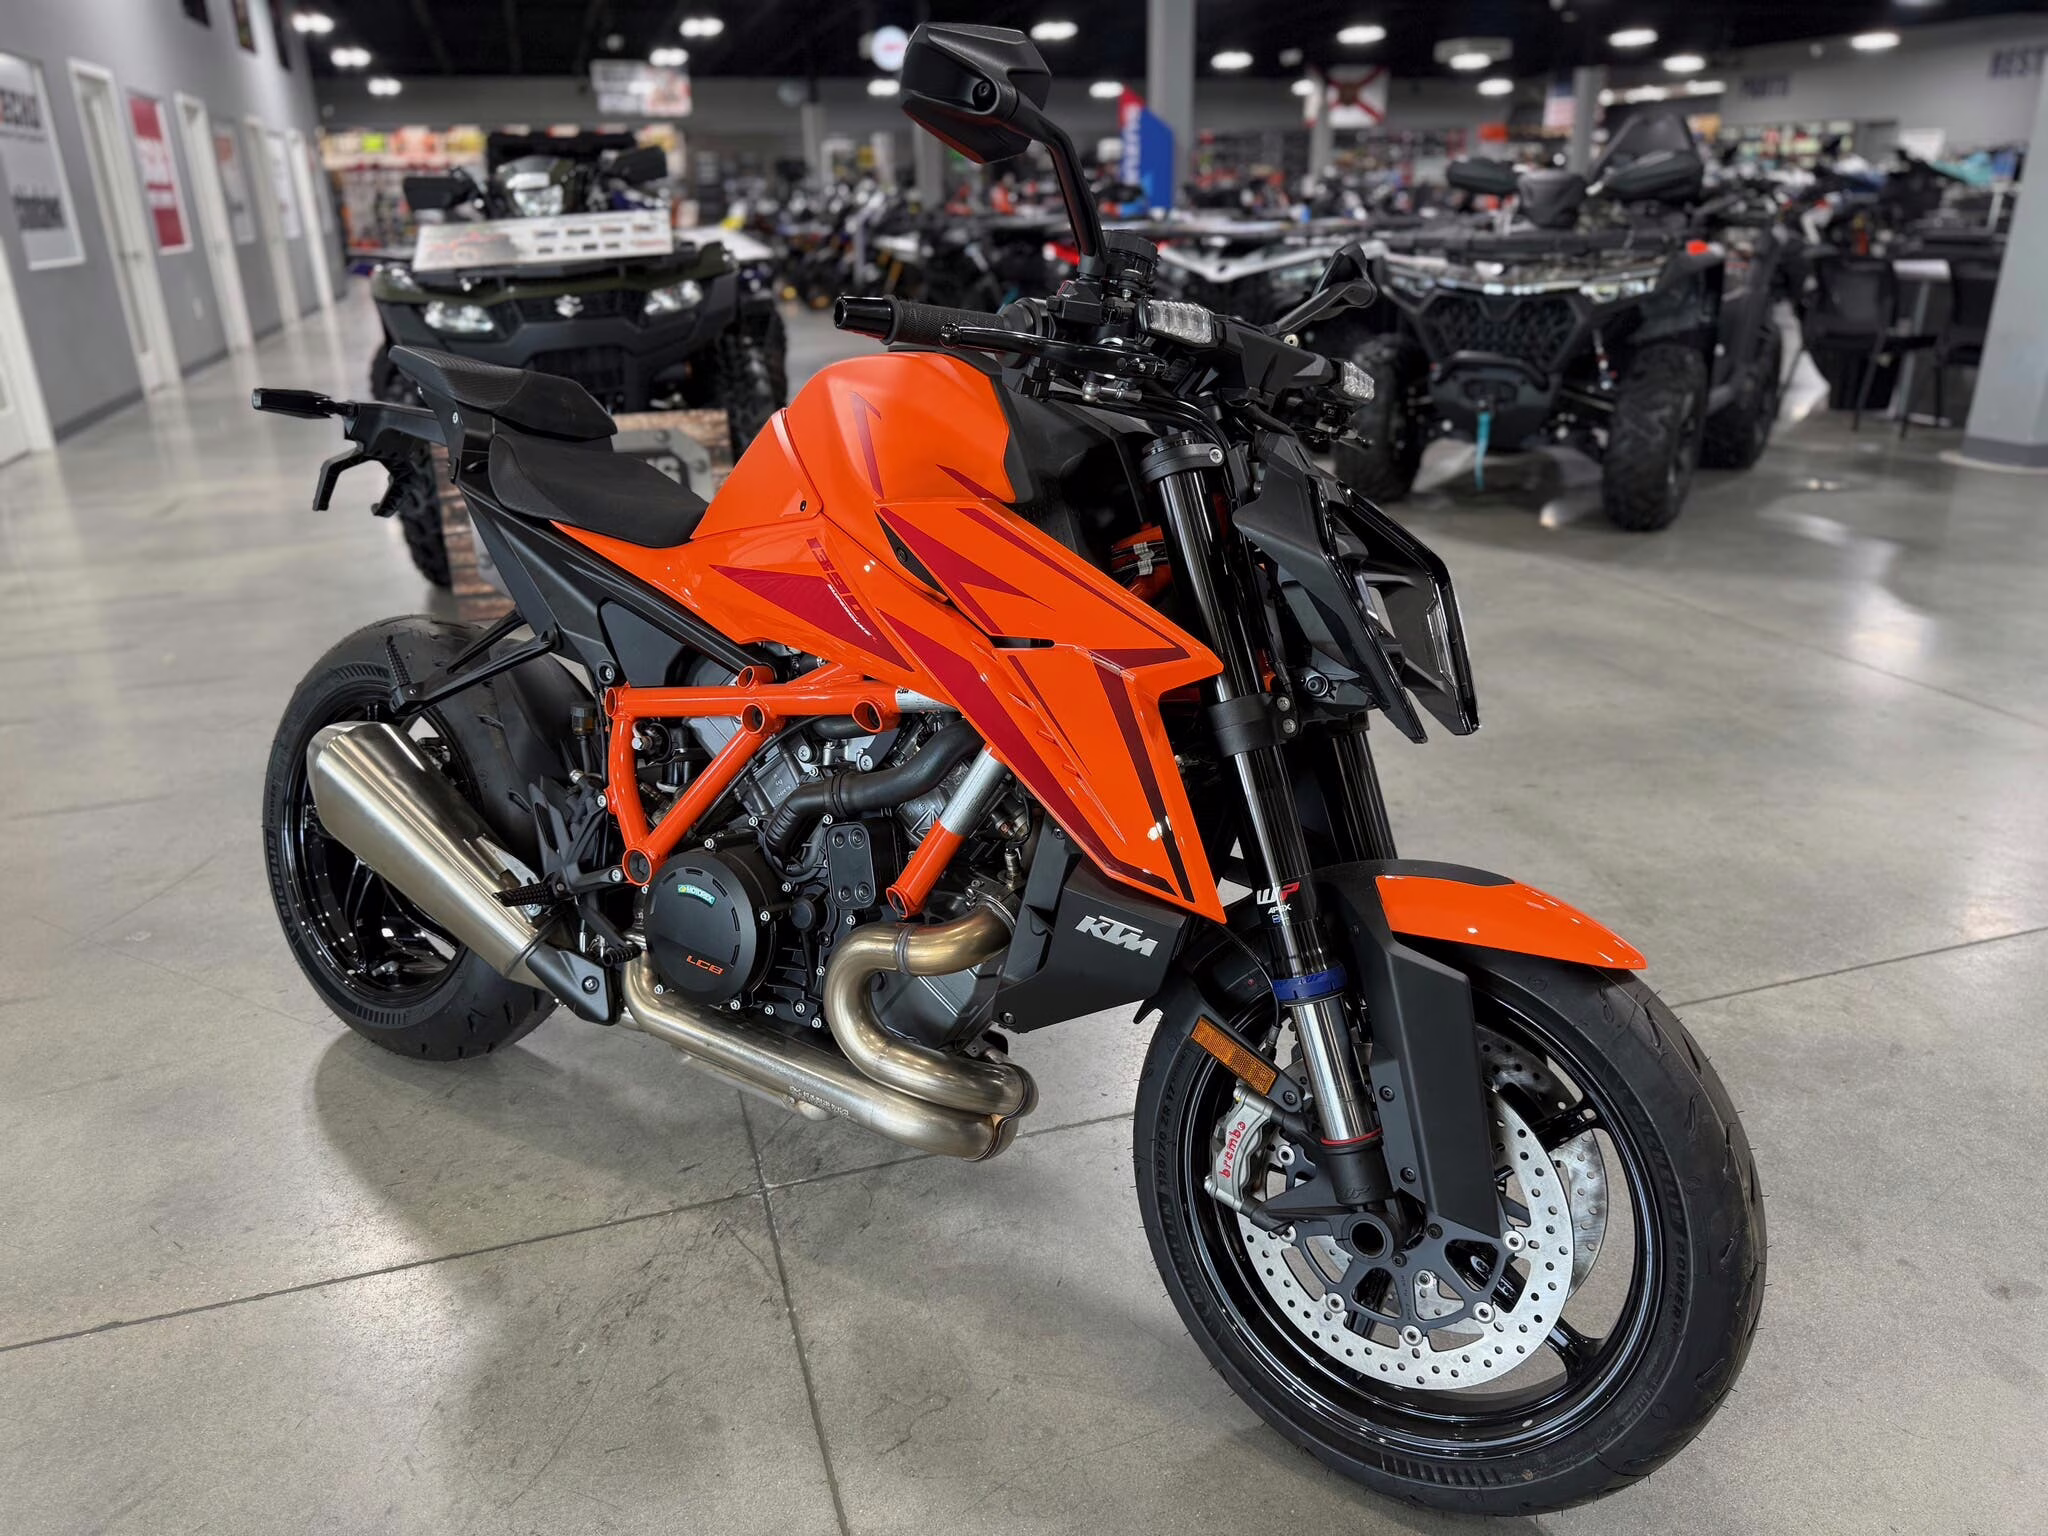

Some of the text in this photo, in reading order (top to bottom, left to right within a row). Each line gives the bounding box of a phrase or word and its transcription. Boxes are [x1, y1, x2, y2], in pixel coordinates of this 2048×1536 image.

[268, 836, 290, 917] MICHELIN
[687, 955, 724, 975] LC8
[1075, 915, 1159, 957] KTM
[1157, 1086, 1176, 1188] 120/70 ZR 17
[1219, 1121, 1246, 1179] brembo
